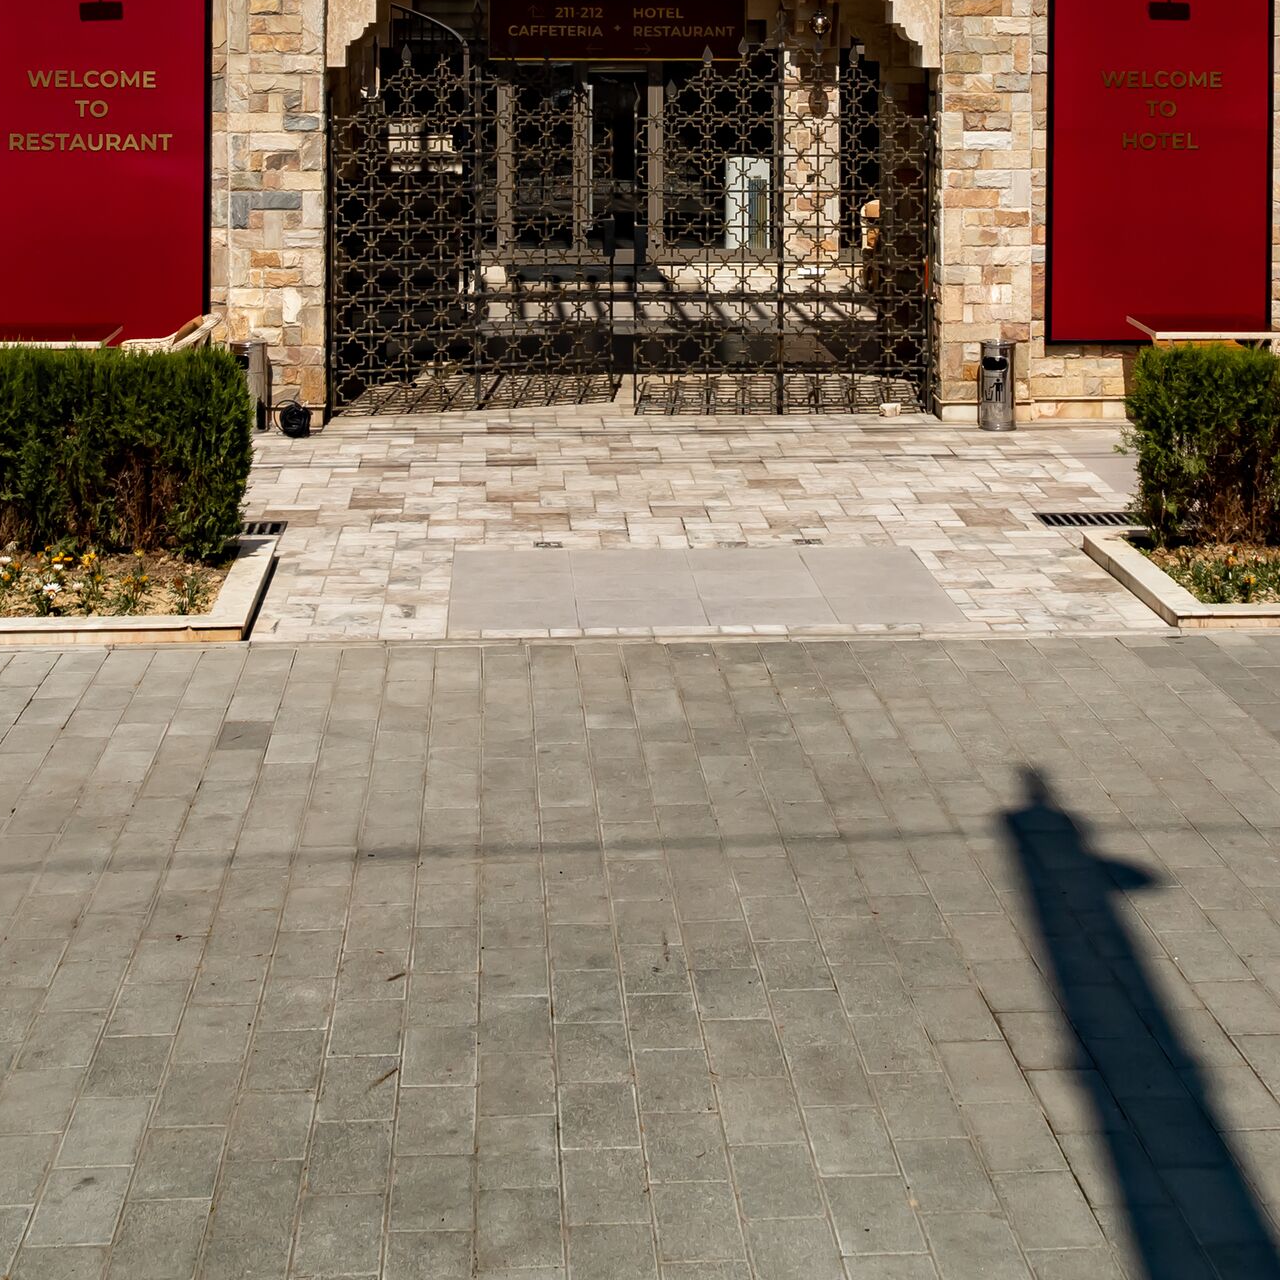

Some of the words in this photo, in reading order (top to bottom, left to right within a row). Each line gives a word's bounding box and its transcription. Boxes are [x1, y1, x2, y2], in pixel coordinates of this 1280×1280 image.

[633, 7, 685, 19] HOTEL
[508, 24, 604, 37] CAFFETERIA
[633, 25, 736, 38] RESTAURANT
[27, 70, 157, 89] WELCOME
[1101, 71, 1224, 89] WELCOME
[74, 99, 109, 118] TO
[1146, 100, 1178, 118] TO
[8, 132, 173, 151] RESTAURANT
[1122, 132, 1199, 150] HOTEL
